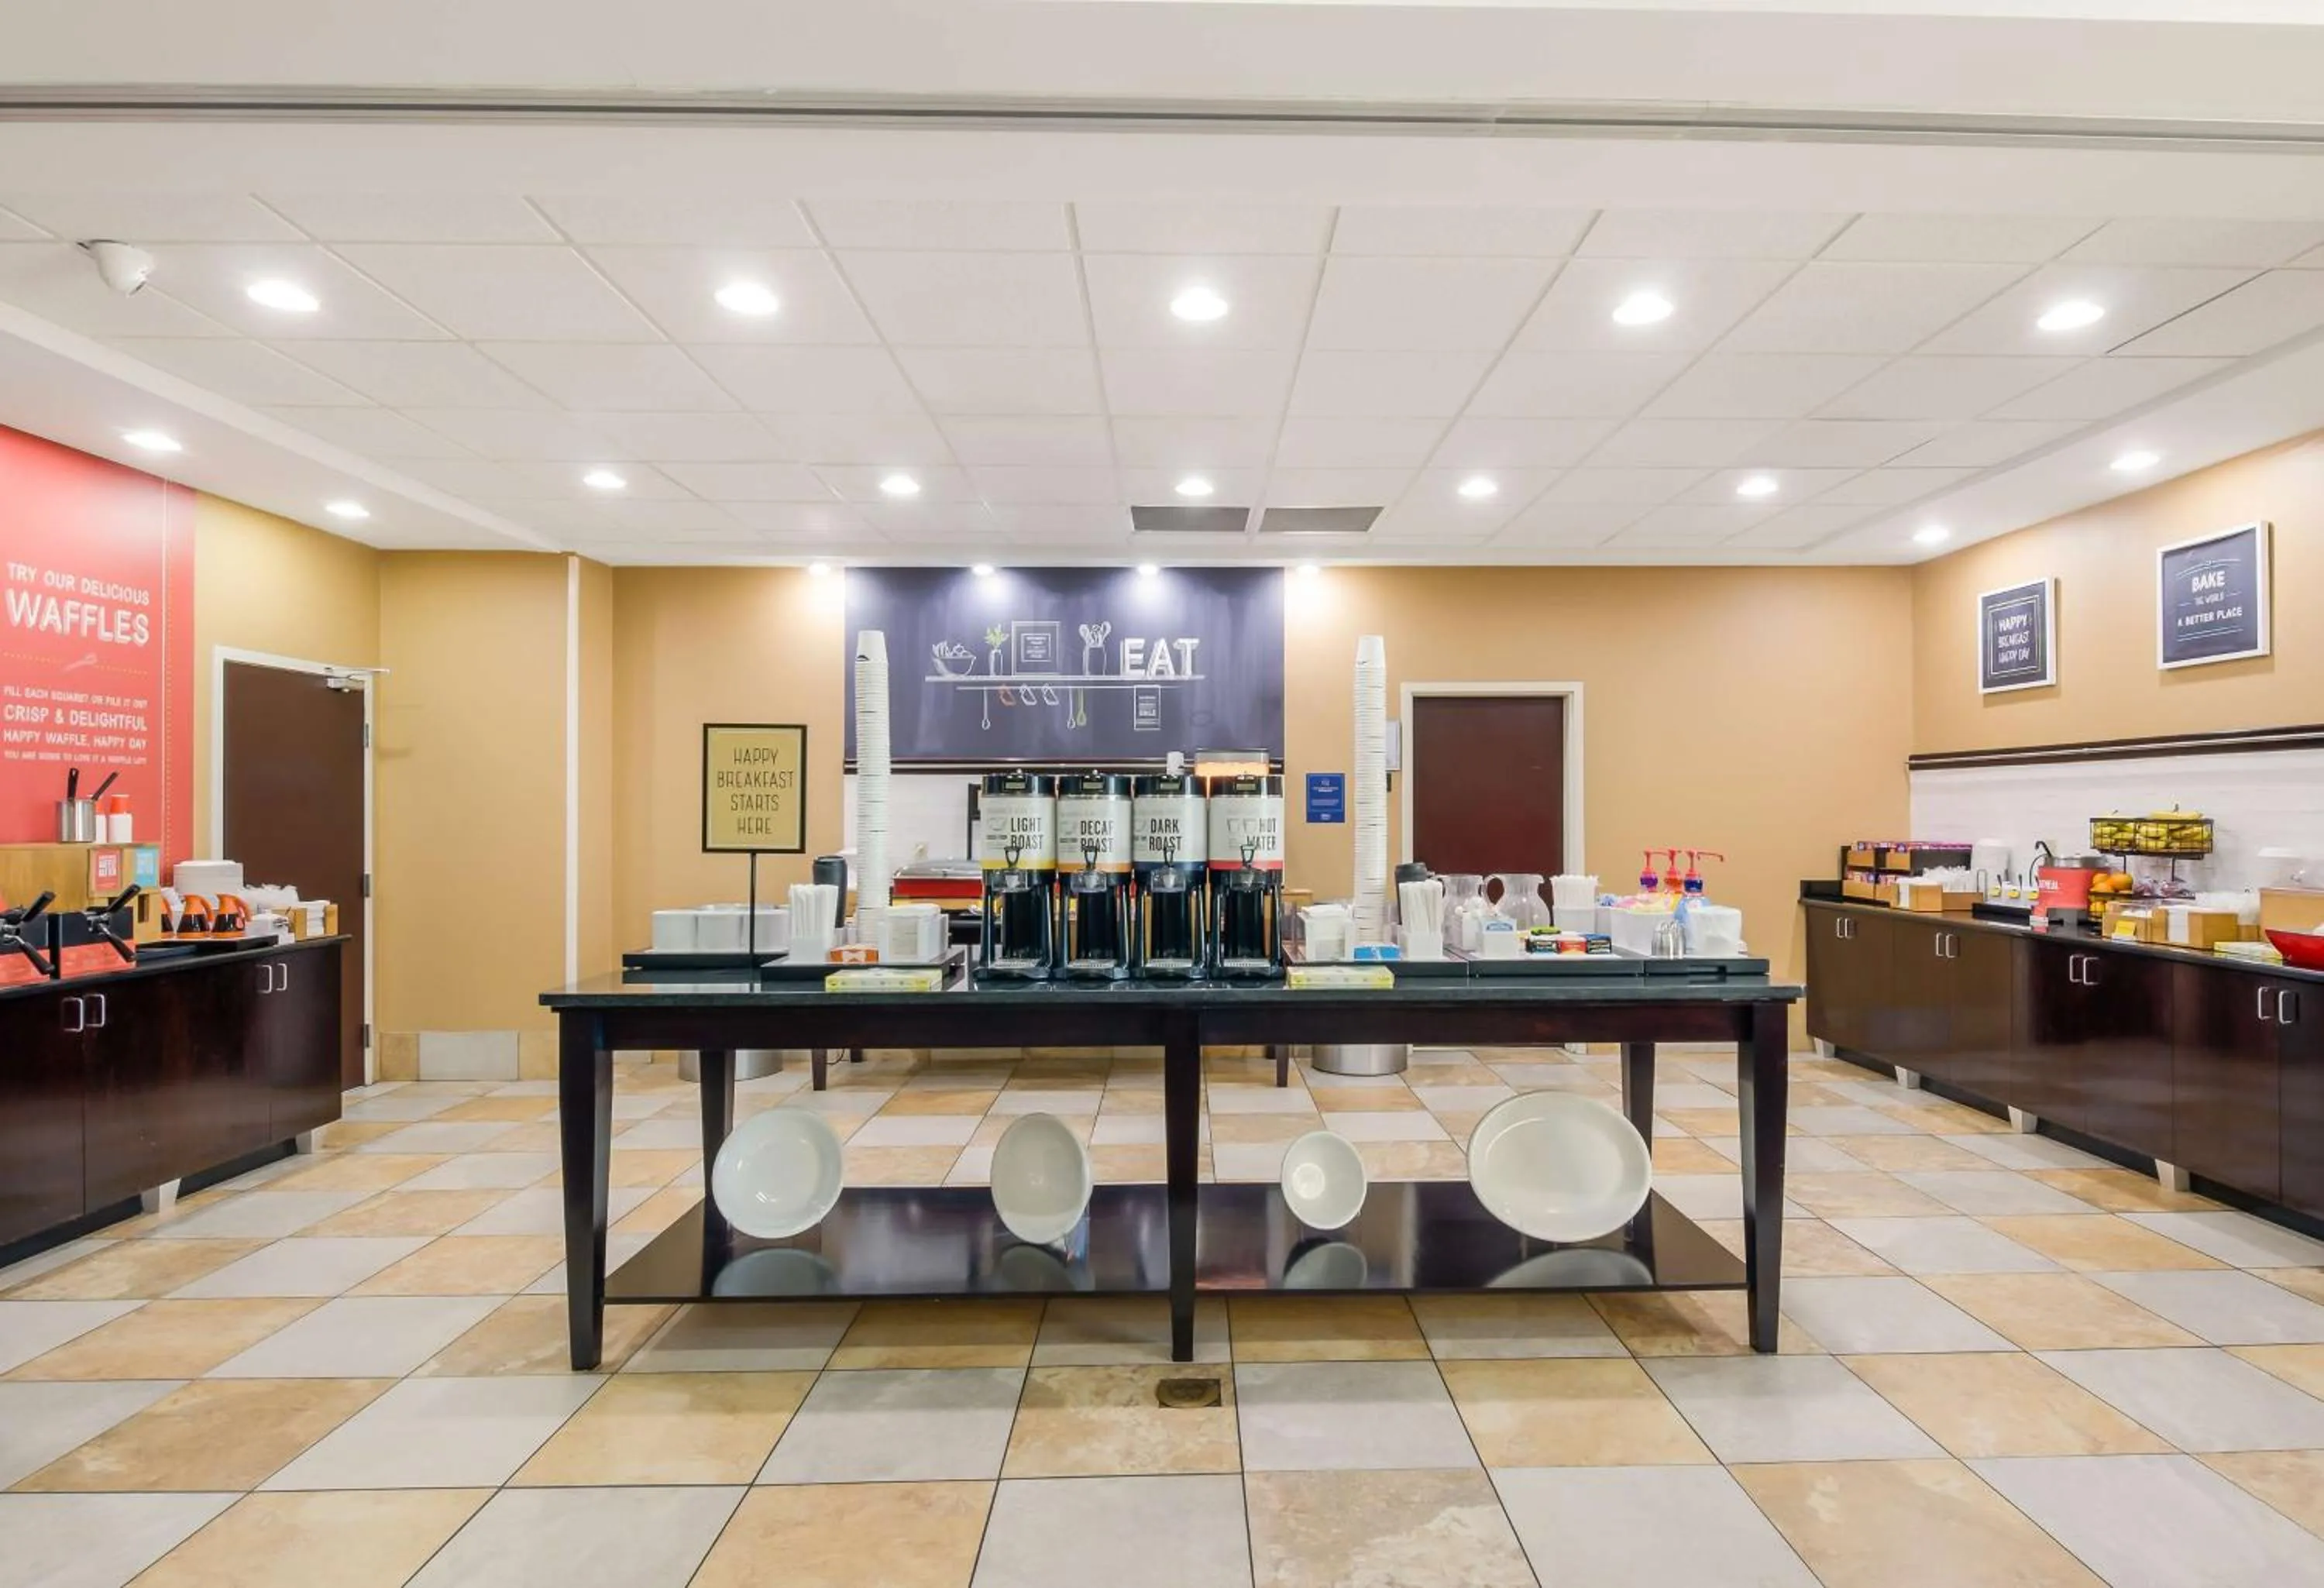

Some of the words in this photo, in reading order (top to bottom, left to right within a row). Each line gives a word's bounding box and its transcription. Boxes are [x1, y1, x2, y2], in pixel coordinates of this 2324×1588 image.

[7, 562, 37, 582] TRY
[43, 570, 75, 591] OUR
[81, 577, 150, 606] DELICIOUS
[2192, 571, 2226, 593] BAKE
[5, 588, 150, 647] WAFFLES
[1999, 614, 2027, 632] HAPPY
[2185, 611, 2215, 627] BETTER
[2216, 607, 2243, 620] PLACE
[1120, 638, 1200, 679] EAT
[4, 704, 49, 723] CRISP
[54, 708, 64, 724] &
[70, 710, 147, 731] DELIGHTFUL
[3, 730, 40, 744] HAPPY
[94, 734, 125, 748] HAPPY
[129, 737, 146, 750] DAY
[734, 747, 779, 765] HAPPY
[717, 771, 794, 789] BREAKFAST
[731, 793, 779, 811] STARTS
[737, 817, 772, 834] HERE
[1011, 817, 1042, 832] LIGHT
[1081, 820, 1114, 835] DECAF
[1150, 818, 1180, 834] DARK
[1259, 817, 1276, 833] HOT
[1011, 834, 1043, 850] ROAST
[1081, 837, 1113, 852] ROAST
[1149, 836, 1183, 851] ROAST
